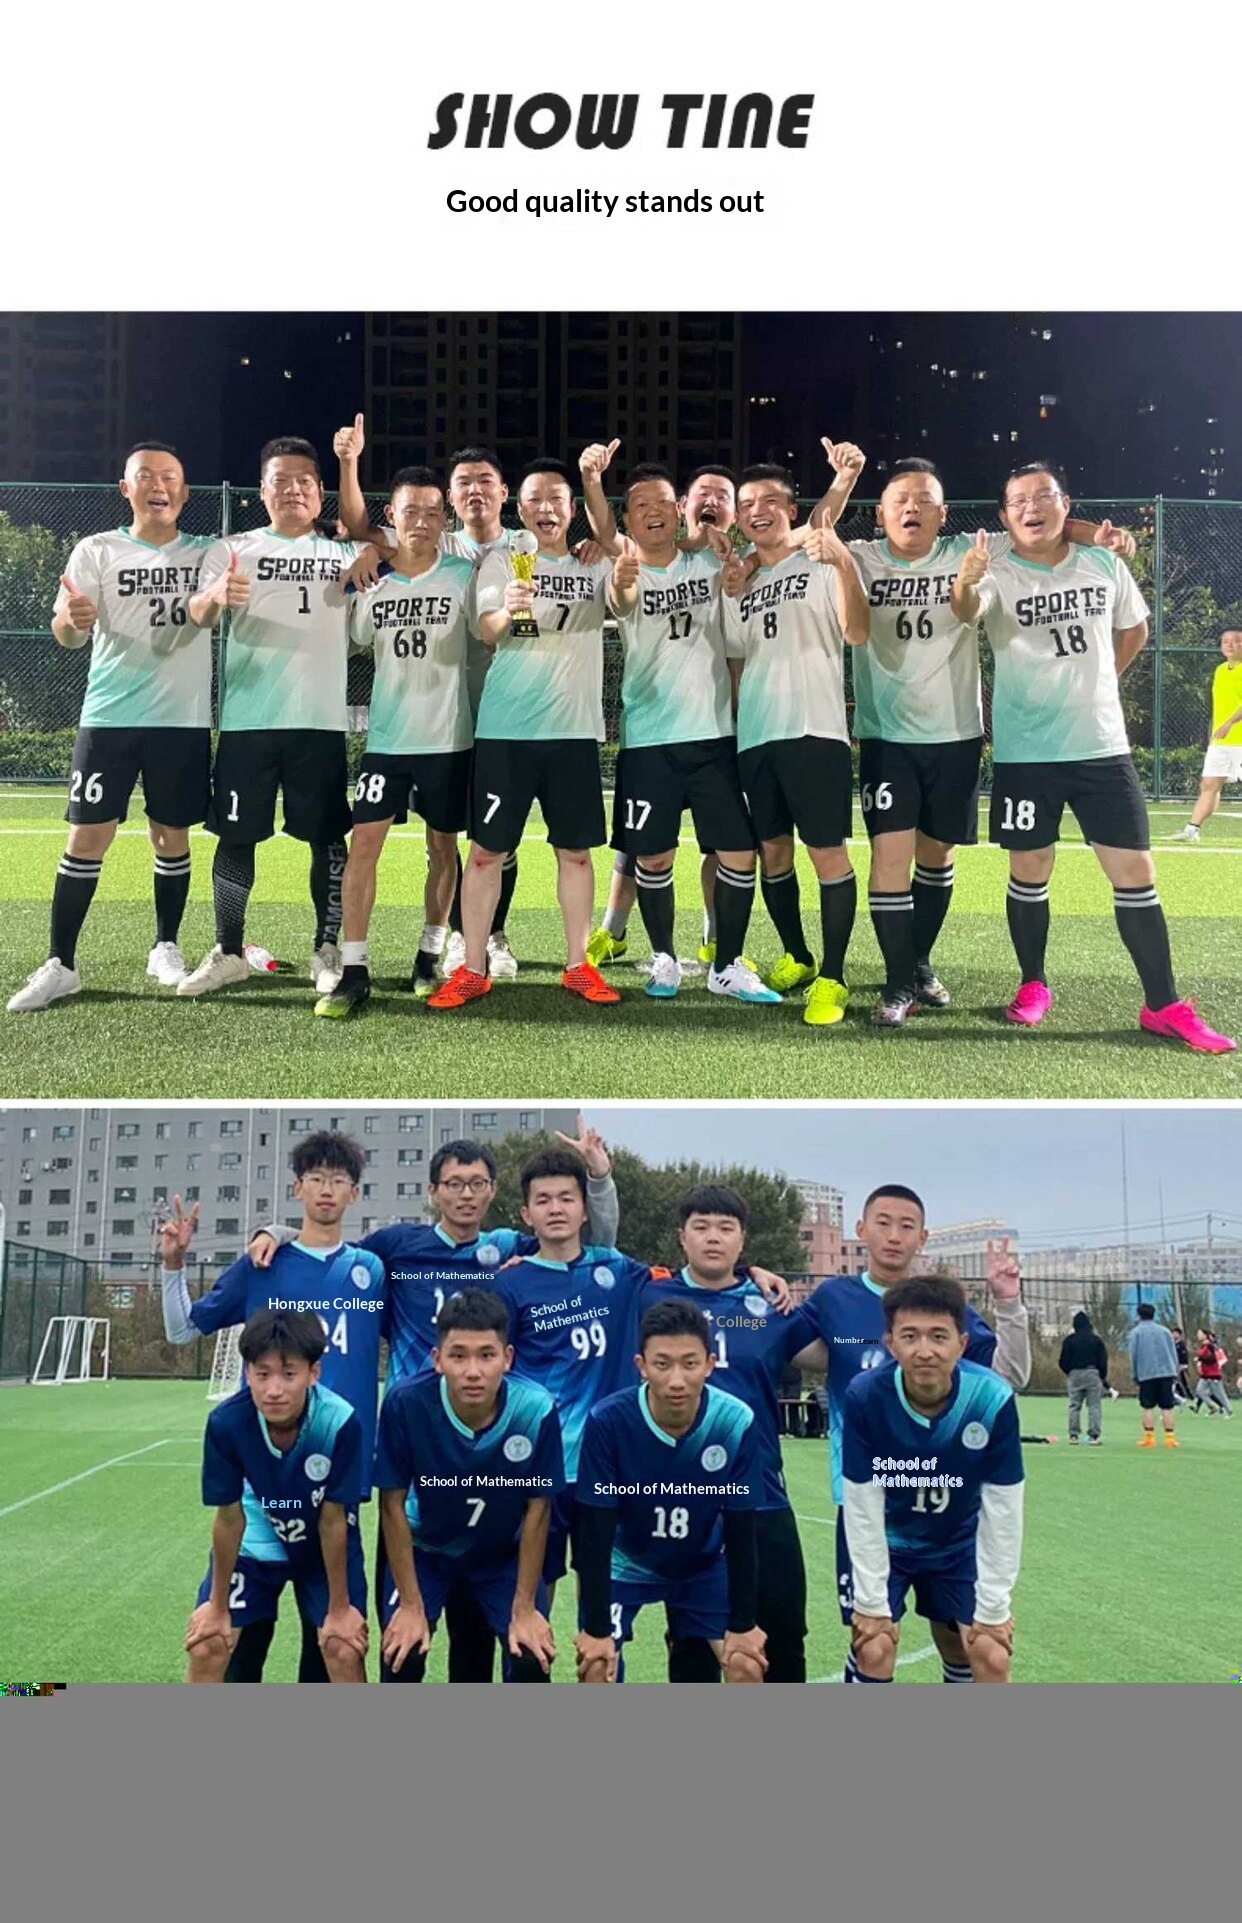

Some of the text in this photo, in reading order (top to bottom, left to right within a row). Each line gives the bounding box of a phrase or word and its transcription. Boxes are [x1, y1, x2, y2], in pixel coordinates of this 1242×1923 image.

[257, 556, 342, 581] SPORTS
[150, 597, 187, 627] 26
[298, 586, 311, 614] 1
[372, 597, 452, 629] SPORTS
[643, 578, 710, 617] SPORTS
[739, 573, 810, 623] SPORTS
[1015, 587, 1107, 627] SPORTS
[556, 603, 570, 631] 7
[668, 611, 693, 641] 17
[763, 610, 778, 639] 8
[896, 609, 934, 641] 66
[393, 629, 427, 659] 68
[1050, 625, 1088, 658] 18
[70, 770, 103, 804] 26
[354, 773, 386, 804] 68
[862, 782, 893, 812] 66
[227, 790, 239, 822] 1
[482, 792, 501, 824] 7
[625, 798, 652, 830] 17
[1001, 797, 1036, 831] 18
[571, 1319, 607, 1360] 99
[466, 1498, 487, 1527] 7
[652, 1506, 690, 1540] 18
